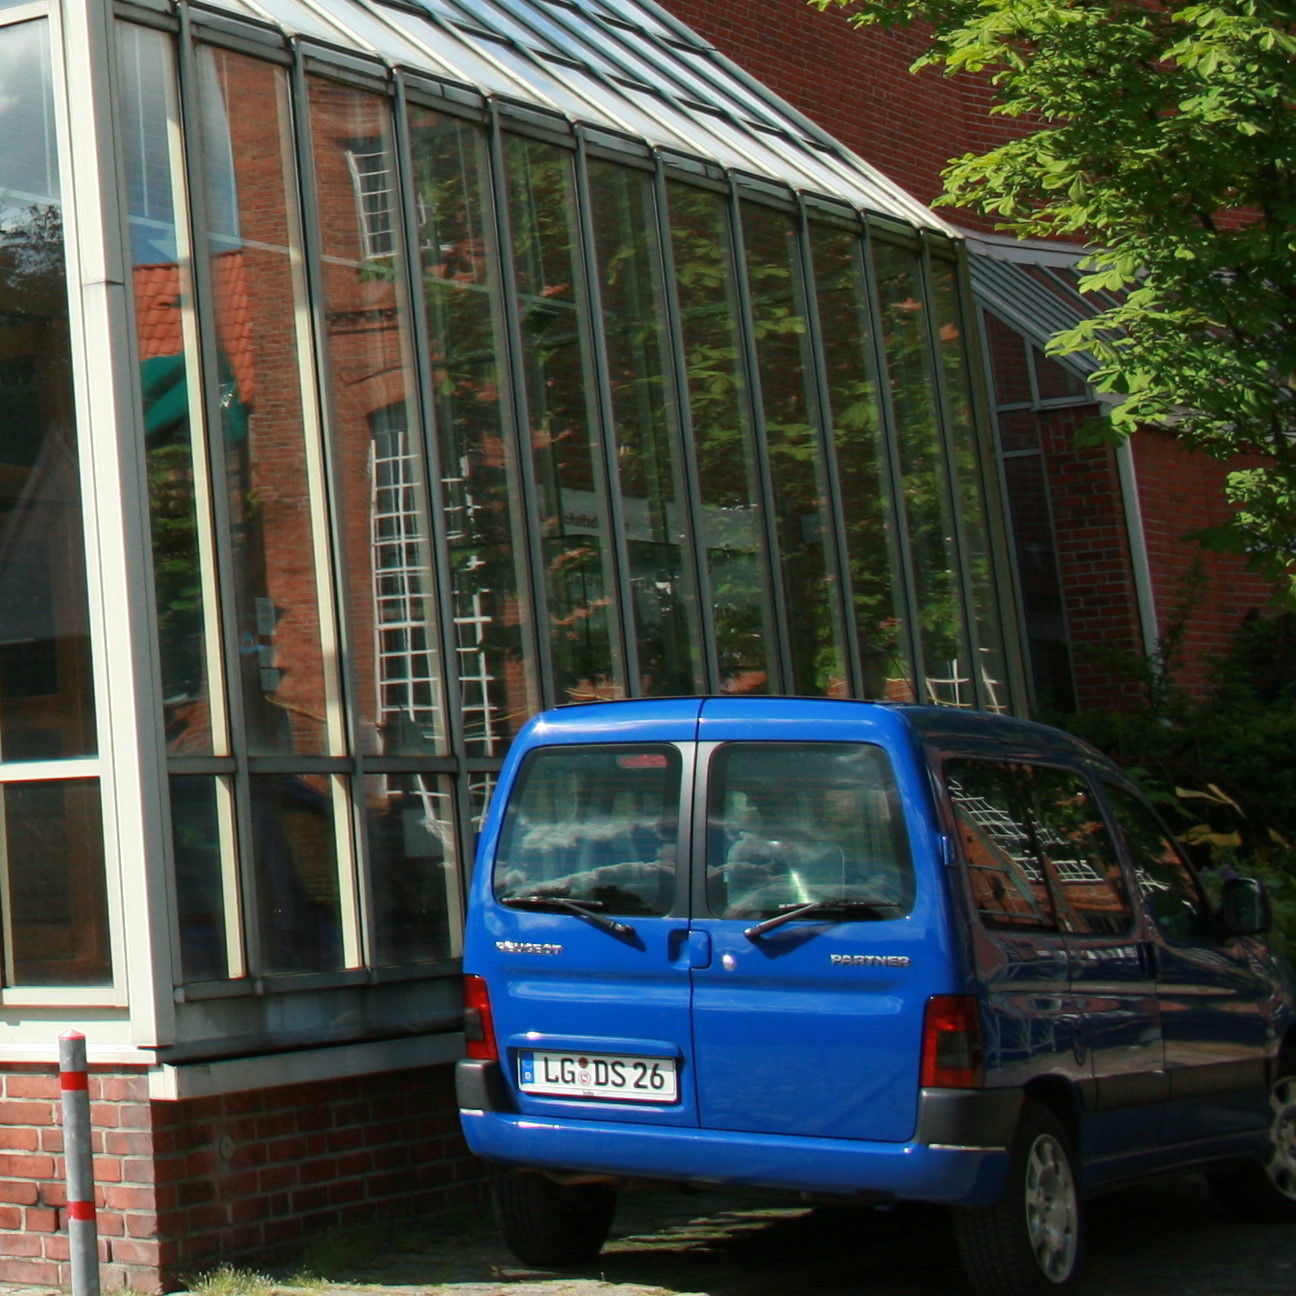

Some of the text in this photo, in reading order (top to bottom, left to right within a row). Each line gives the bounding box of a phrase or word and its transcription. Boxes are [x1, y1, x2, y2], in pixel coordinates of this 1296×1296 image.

[830, 953, 911, 967] PARTNER
[543, 1056, 576, 1084] LG
[593, 1058, 626, 1088] DS
[632, 1061, 665, 1090] 26
